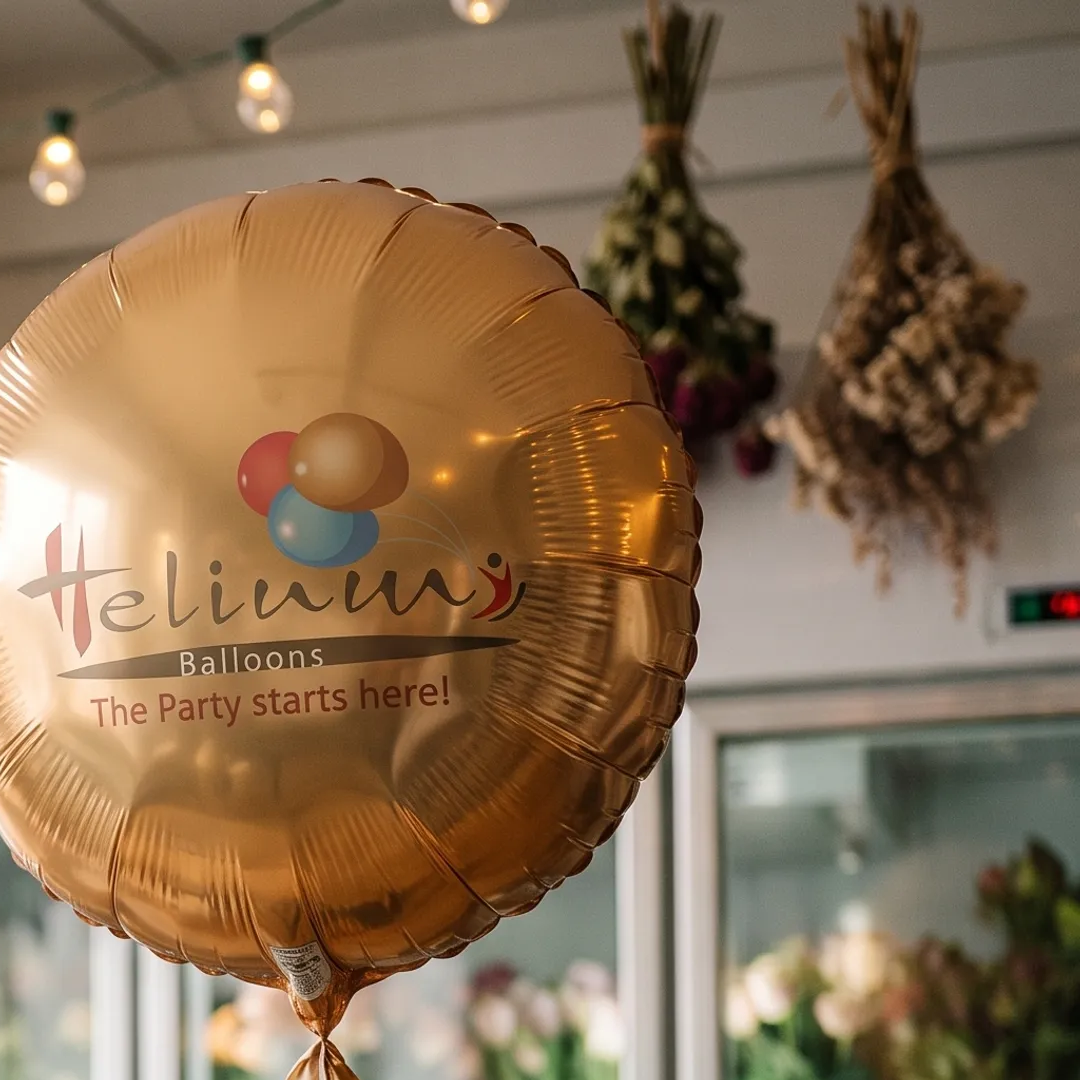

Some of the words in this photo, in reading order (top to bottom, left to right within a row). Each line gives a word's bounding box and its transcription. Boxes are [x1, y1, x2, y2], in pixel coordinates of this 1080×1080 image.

[180, 646, 324, 677] Balloons
[90, 696, 148, 728] The
[158, 692, 242, 728] Party
[252, 685, 348, 717] starts
[358, 675, 450, 710] here!
